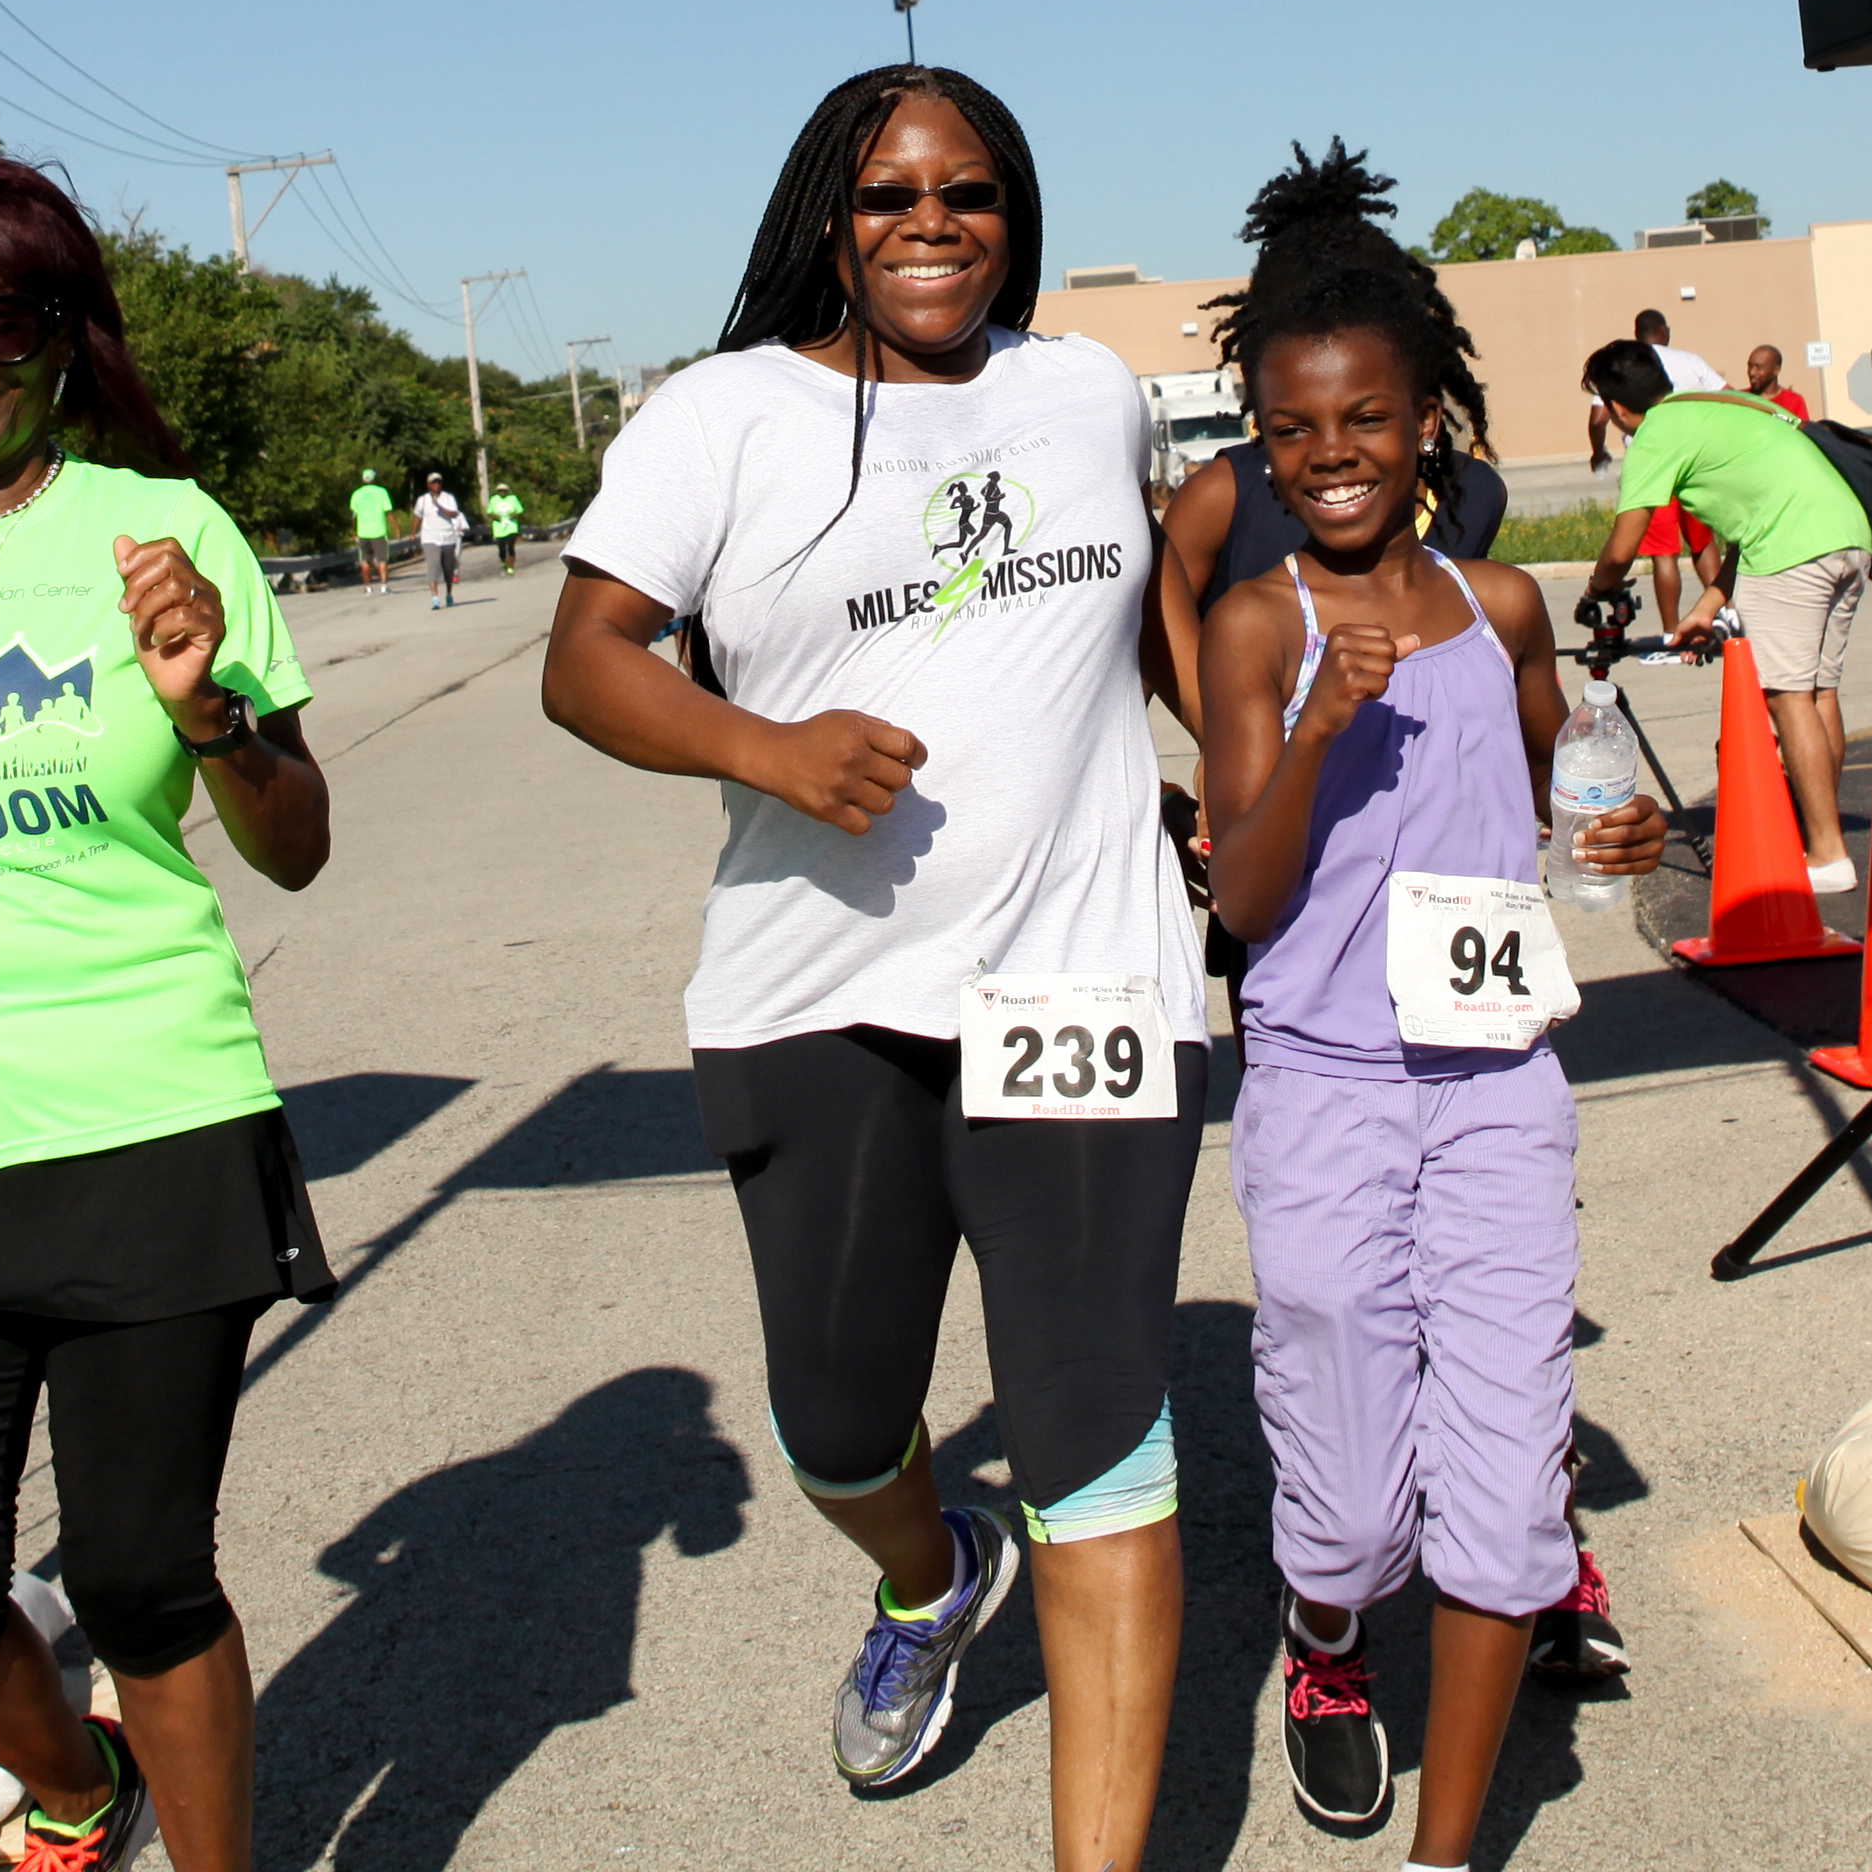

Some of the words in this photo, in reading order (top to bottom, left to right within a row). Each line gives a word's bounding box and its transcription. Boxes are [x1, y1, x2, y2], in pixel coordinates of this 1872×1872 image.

[1008, 436, 1051, 456] CLUB
[33, 583, 95, 599] Center
[846, 580, 940, 631] MILES
[981, 543, 1122, 601] MISSIONS
[911, 612, 945, 630] RUN
[954, 603, 987, 621] AND
[999, 590, 1048, 614] WALK
[0, 836, 57, 856] CLUB
[87, 842, 110, 857] Time
[1449, 926, 1532, 996] 94
[1001, 995, 1050, 1006] RoadID
[1454, 1001, 1533, 1013] RoadID.com
[1001, 1025, 1144, 1098] 239
[1032, 1104, 1121, 1116] RoadID.com
